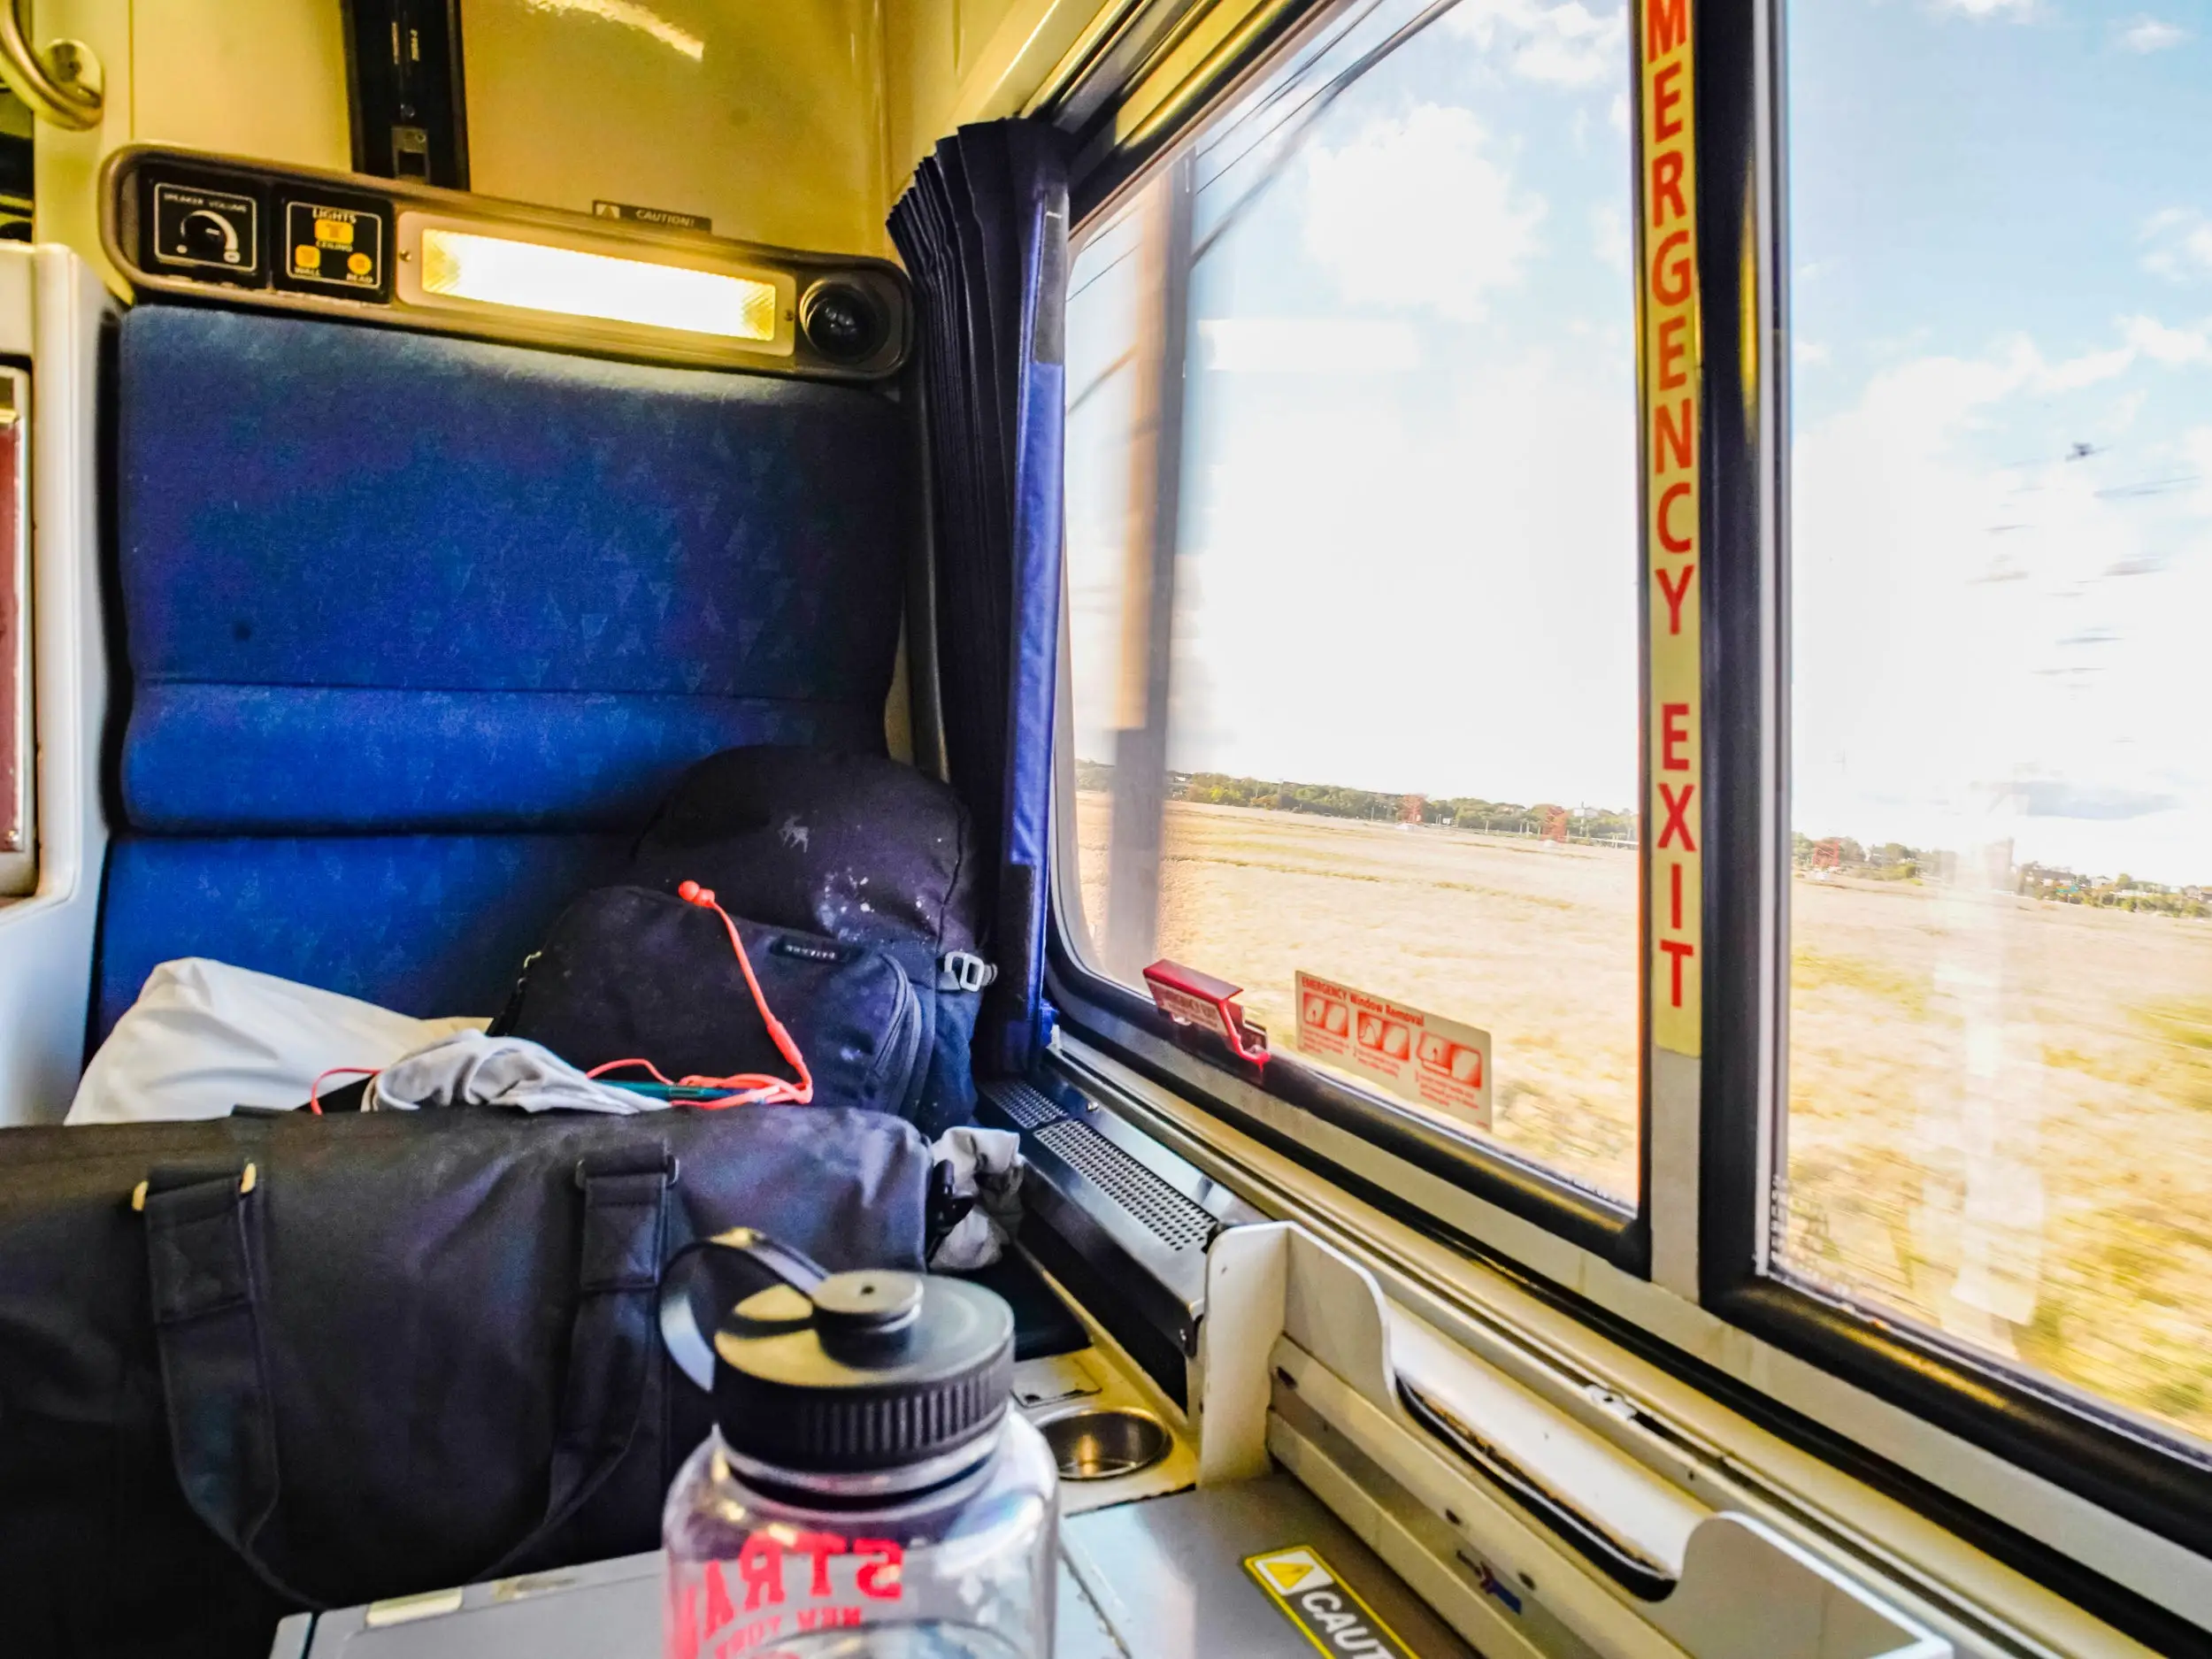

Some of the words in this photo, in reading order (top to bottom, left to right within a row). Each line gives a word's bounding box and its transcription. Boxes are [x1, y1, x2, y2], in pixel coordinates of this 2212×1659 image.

[313, 206, 357, 224] LIGHTS
[1657, 703, 1696, 1008] EXIT
[1302, 977, 1347, 1000] EMERGENCY
[1350, 993, 1383, 1013] Window
[1386, 1004, 1424, 1026] Removal
